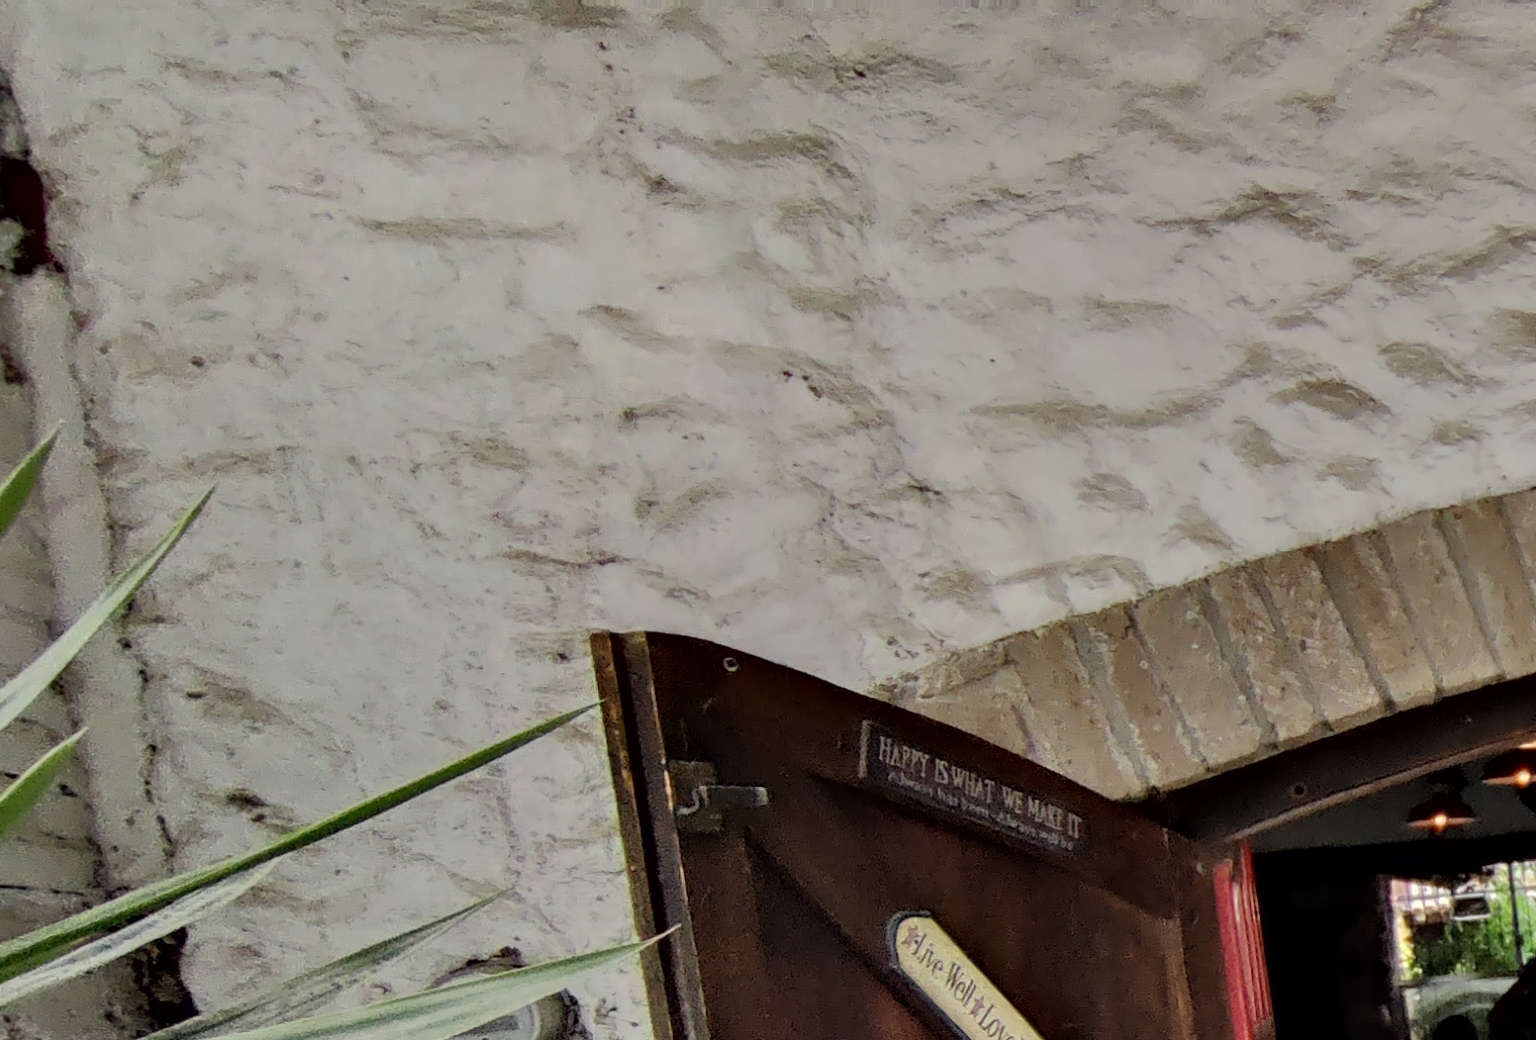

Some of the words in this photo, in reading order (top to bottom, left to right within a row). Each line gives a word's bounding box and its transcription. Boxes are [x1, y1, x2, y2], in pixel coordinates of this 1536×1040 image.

[878, 736, 930, 777] HAPPY
[934, 758, 949, 785] IS
[951, 766, 995, 803] WHAT
[1002, 786, 1023, 814] WE
[1027, 796, 1064, 830] MAKE
[1067, 814, 1083, 839] IT
[911, 933, 944, 980] Live
[945, 962, 977, 1009] Well
